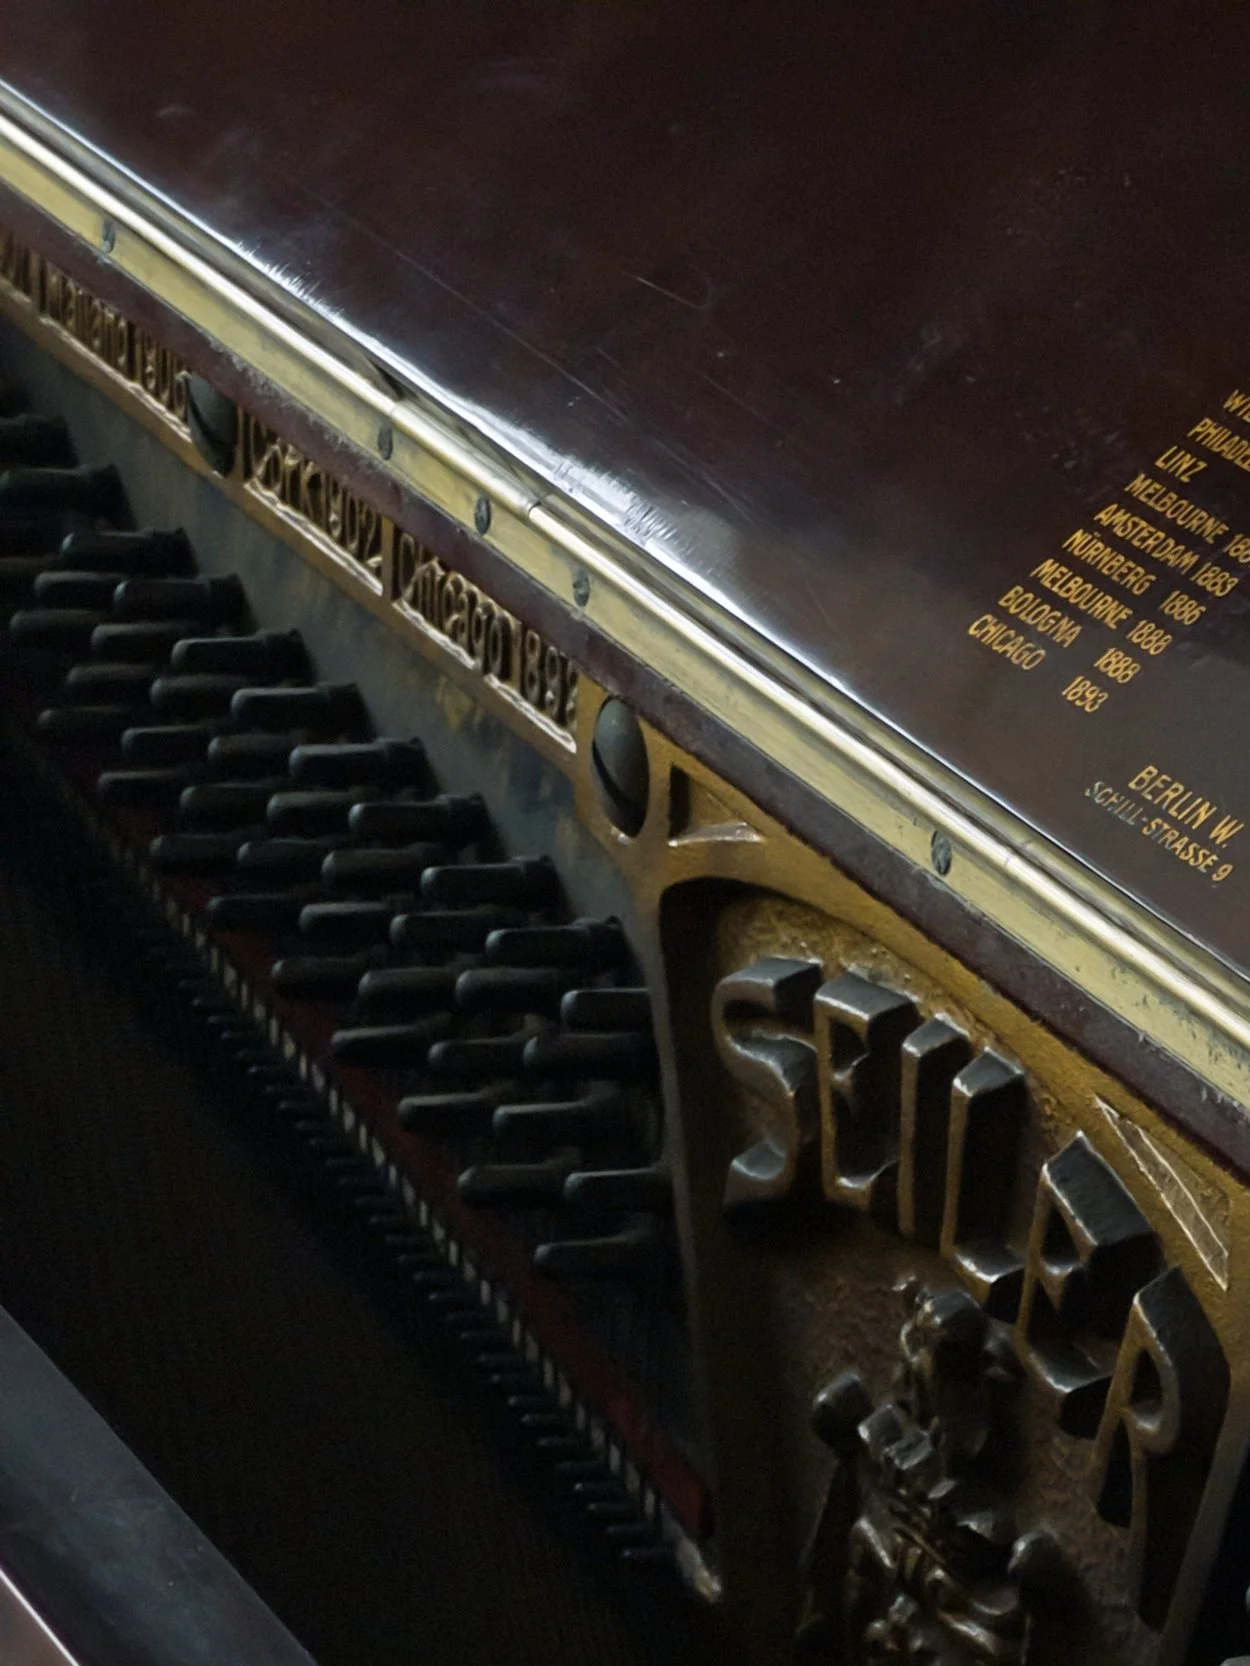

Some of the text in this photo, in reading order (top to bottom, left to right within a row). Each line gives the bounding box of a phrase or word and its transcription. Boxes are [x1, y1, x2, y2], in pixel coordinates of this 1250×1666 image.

[1123, 472, 1230, 545] MELBOURNE
[1154, 446, 1208, 484] LINZ
[1062, 528, 1206, 626] NÜRNBERG 1886
[1093, 503, 1240, 598] AMSTERDAM 1883
[997, 585, 1142, 684] BOLOGNA 1888
[1029, 557, 1173, 656] MELBOURNE 1888
[967, 613, 1109, 713] CHICAGO 1893
[1128, 765, 1245, 849] BERLIN W.
[1212, 863, 1235, 883] 9
[710, 955, 1203, 1612] SEILER
